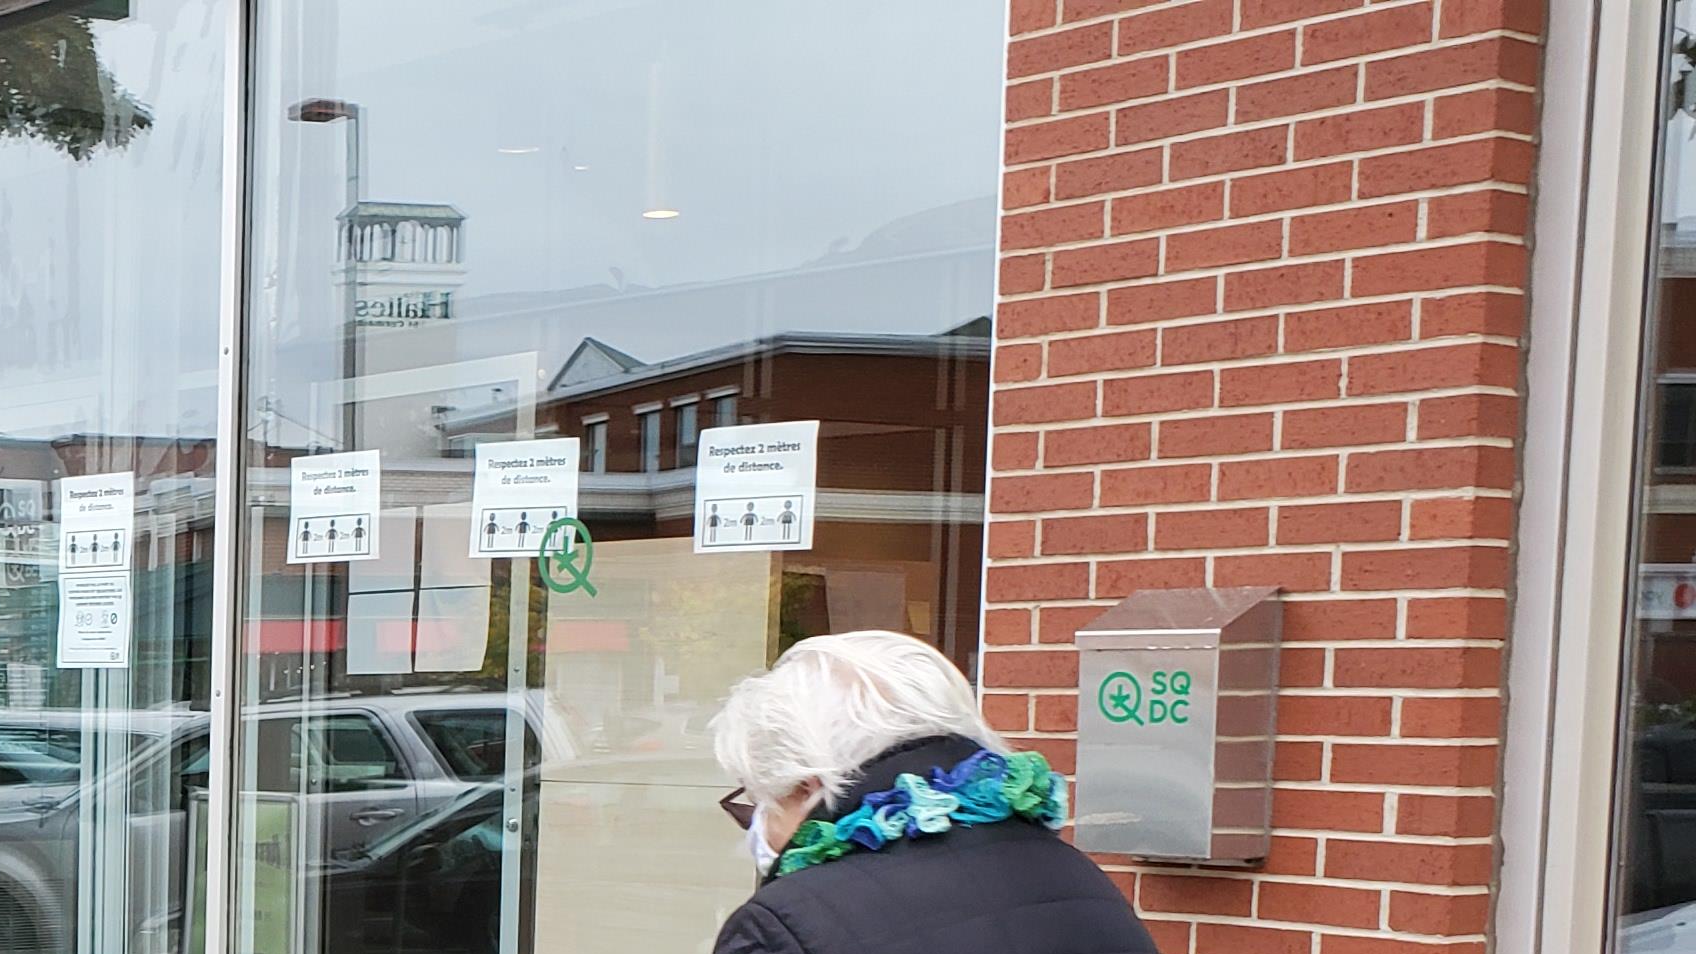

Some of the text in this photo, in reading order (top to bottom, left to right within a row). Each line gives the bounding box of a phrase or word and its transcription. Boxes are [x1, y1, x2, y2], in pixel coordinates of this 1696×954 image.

[708, 441, 801, 458] Respectez 2 mètres
[488, 459, 528, 470] Respectez
[724, 461, 784, 474] de distance.
[501, 475, 512, 485] de
[723, 517, 738, 528] 2m
[760, 516, 776, 526] 2m
[1151, 671, 1192, 696] SQ
[1149, 699, 1190, 724] DC
